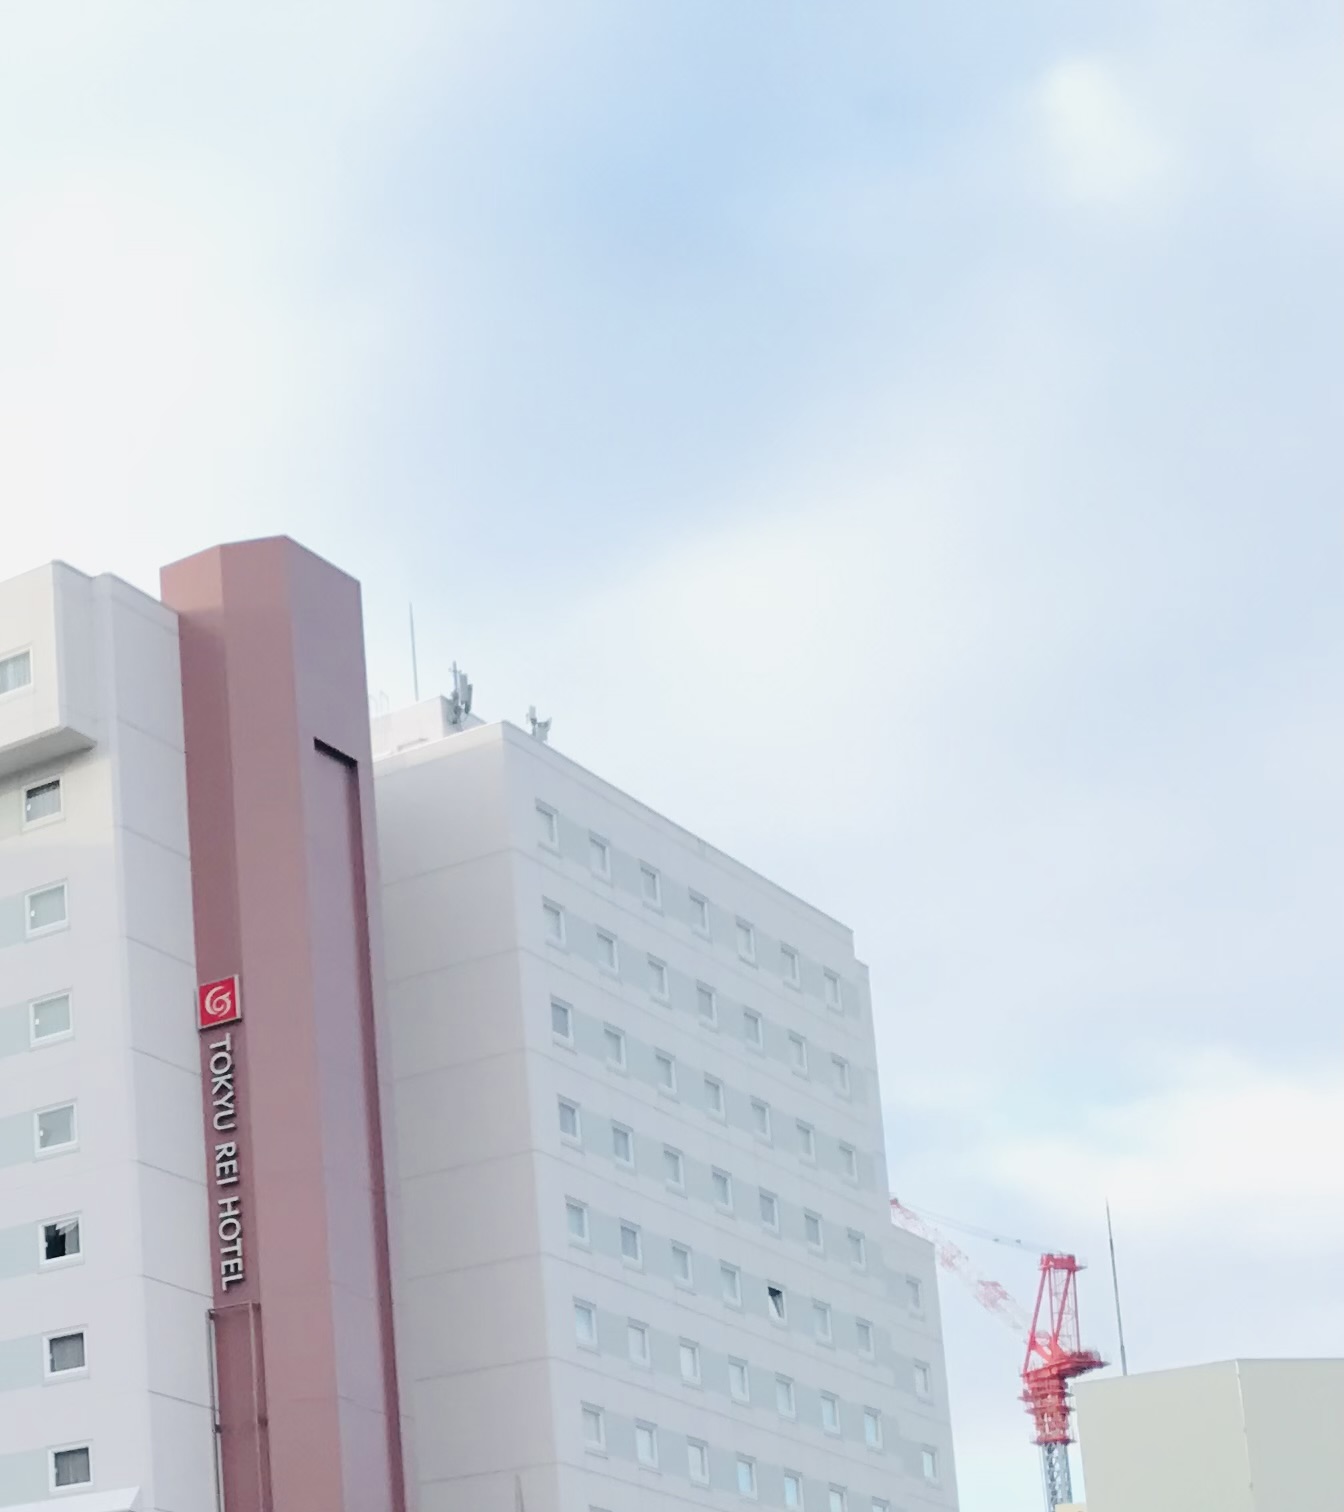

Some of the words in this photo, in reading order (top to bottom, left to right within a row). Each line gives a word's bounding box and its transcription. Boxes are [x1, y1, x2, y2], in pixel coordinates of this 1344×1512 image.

[209, 1033, 237, 1131] TOKYU
[214, 1141, 239, 1185] REI
[217, 1196, 244, 1291] HOTEL
